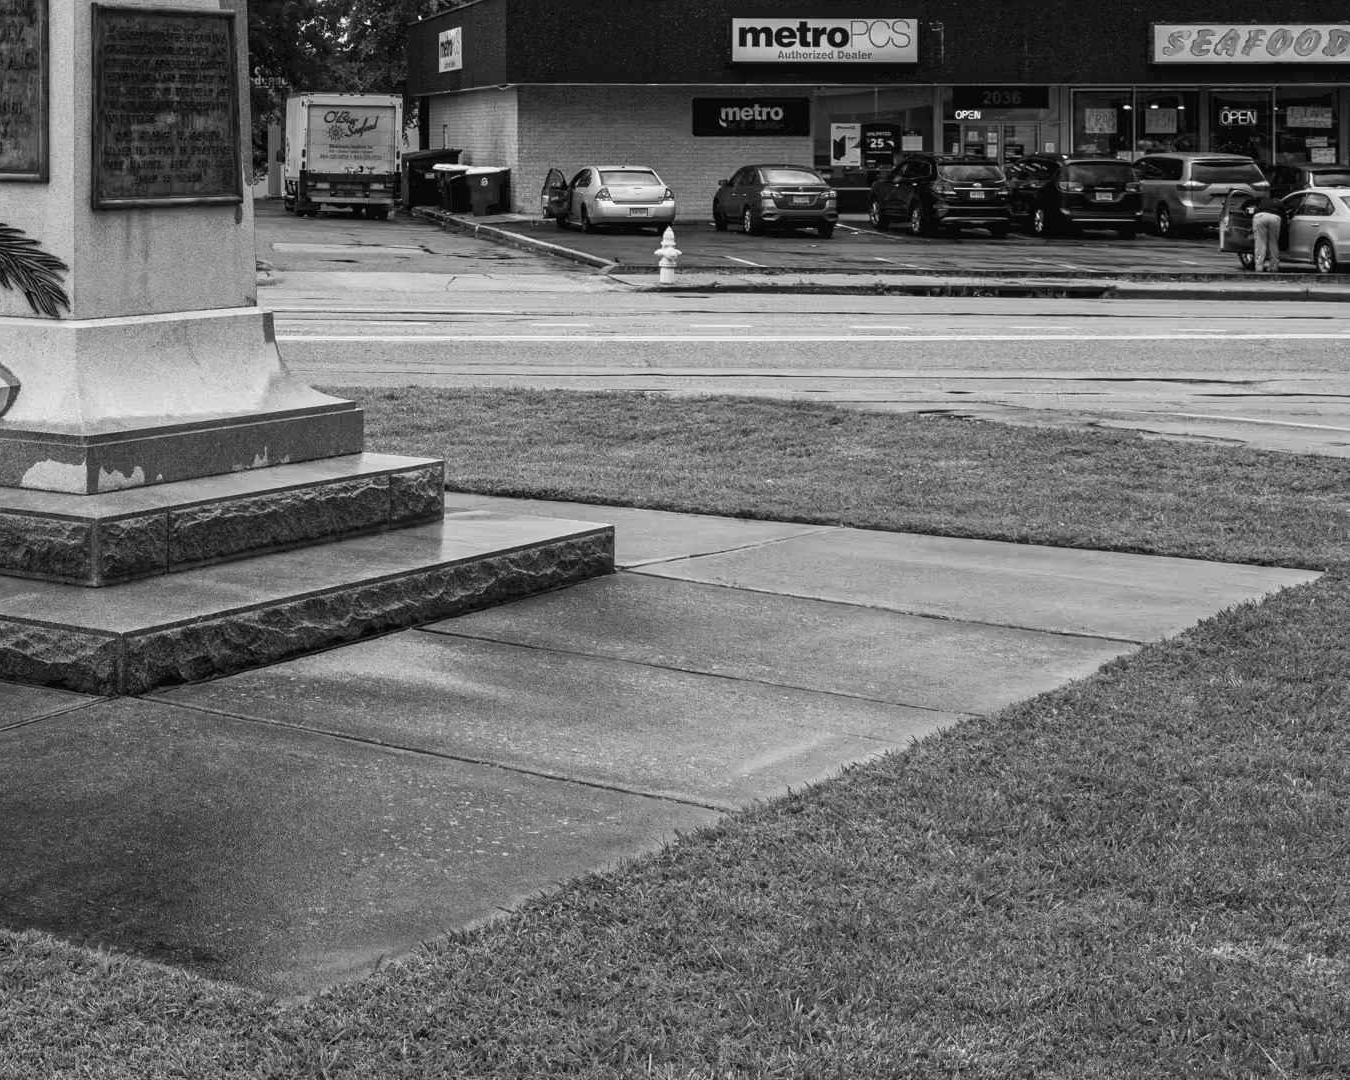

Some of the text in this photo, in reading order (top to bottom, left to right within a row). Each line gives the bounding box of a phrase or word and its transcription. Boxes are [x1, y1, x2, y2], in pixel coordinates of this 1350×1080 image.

[738, 20, 911, 49] metroPCS
[1162, 28, 1350, 57] SEAFOOD
[778, 50, 872, 60] Authorized Dealer
[721, 104, 783, 120] metro
[955, 110, 981, 119] OPEN
[1221, 111, 1256, 124] OPEN
